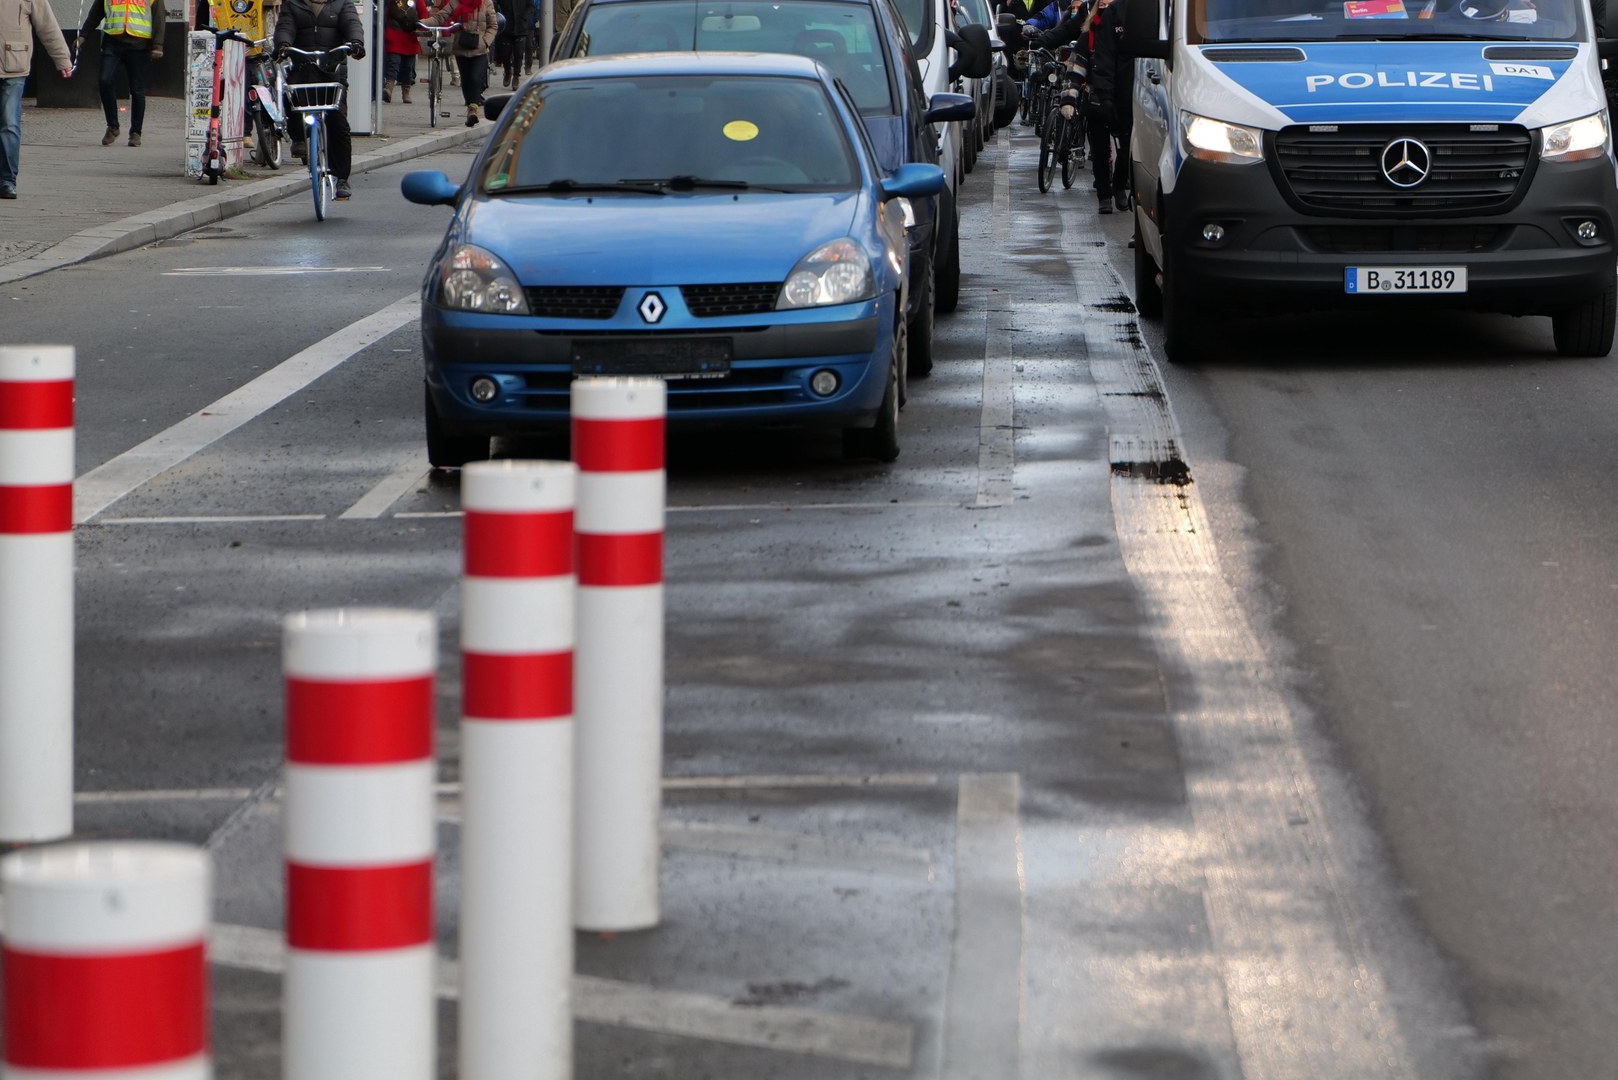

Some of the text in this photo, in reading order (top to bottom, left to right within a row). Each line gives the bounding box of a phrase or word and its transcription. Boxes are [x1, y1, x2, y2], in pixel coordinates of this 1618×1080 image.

[1504, 65, 1539, 76] DA1
[1306, 71, 1494, 93] POLIZEI
[1367, 271, 1380, 289] B
[1394, 270, 1455, 289] 31189
